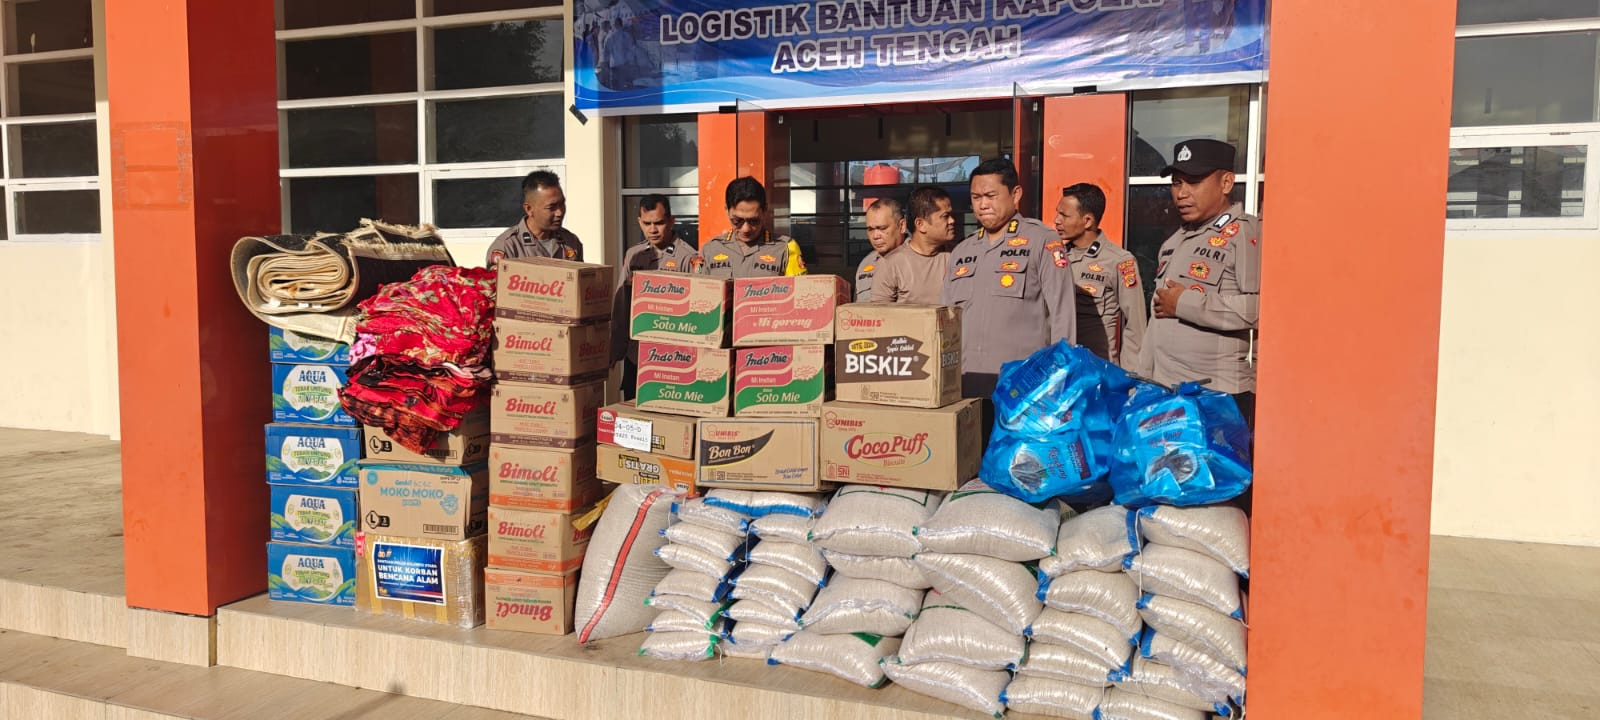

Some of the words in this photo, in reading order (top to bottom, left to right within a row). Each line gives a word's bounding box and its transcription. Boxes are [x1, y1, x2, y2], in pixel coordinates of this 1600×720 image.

[661, 5, 809, 43] LOGISTIK
[817, 0, 984, 32] BANTUAN
[773, 39, 864, 71] ACEH
[872, 26, 1020, 66] TENGAH
[1000, 249, 1031, 258] POLRI
[1194, 247, 1226, 262] POLRI
[754, 262, 780, 273] POLRI
[955, 256, 978, 266] ADI
[1081, 272, 1105, 282] POLRI
[507, 274, 565, 298] Bimoli
[653, 319, 676, 331] Soto
[678, 322, 697, 333] Mie
[758, 317, 771, 327] Mi
[771, 318, 813, 329] goreng
[850, 319, 882, 328] UNIBIS
[505, 335, 553, 351] Bimoli
[845, 353, 912, 376] BISKIZ
[299, 370, 326, 384] AQUA
[658, 388, 682, 400] Soto
[684, 391, 704, 402] Mie
[756, 392, 779, 403] Soto
[781, 392, 800, 403] Mie
[505, 397, 557, 415] Bimoli
[835, 419, 863, 427] UNIBIS
[297, 437, 326, 449] AQUA
[848, 434, 890, 459] Coco
[891, 432, 929, 455] Puff
[708, 445, 731, 460] Bon
[733, 444, 752, 456] Bon
[499, 461, 560, 483] Bimoli
[625, 459, 660, 473] GRATIS
[380, 487, 410, 497] MOKO
[412, 488, 444, 498] MOKO
[300, 497, 326, 510] AQUA
[497, 521, 545, 539] Bimoli
[298, 557, 324, 570] AQUA
[377, 564, 403, 573] UNTUK
[405, 567, 438, 577] KORBAN
[378, 571, 415, 583] BENCANA
[416, 575, 439, 585] ALAM
[496, 601, 553, 622] Bimoli
